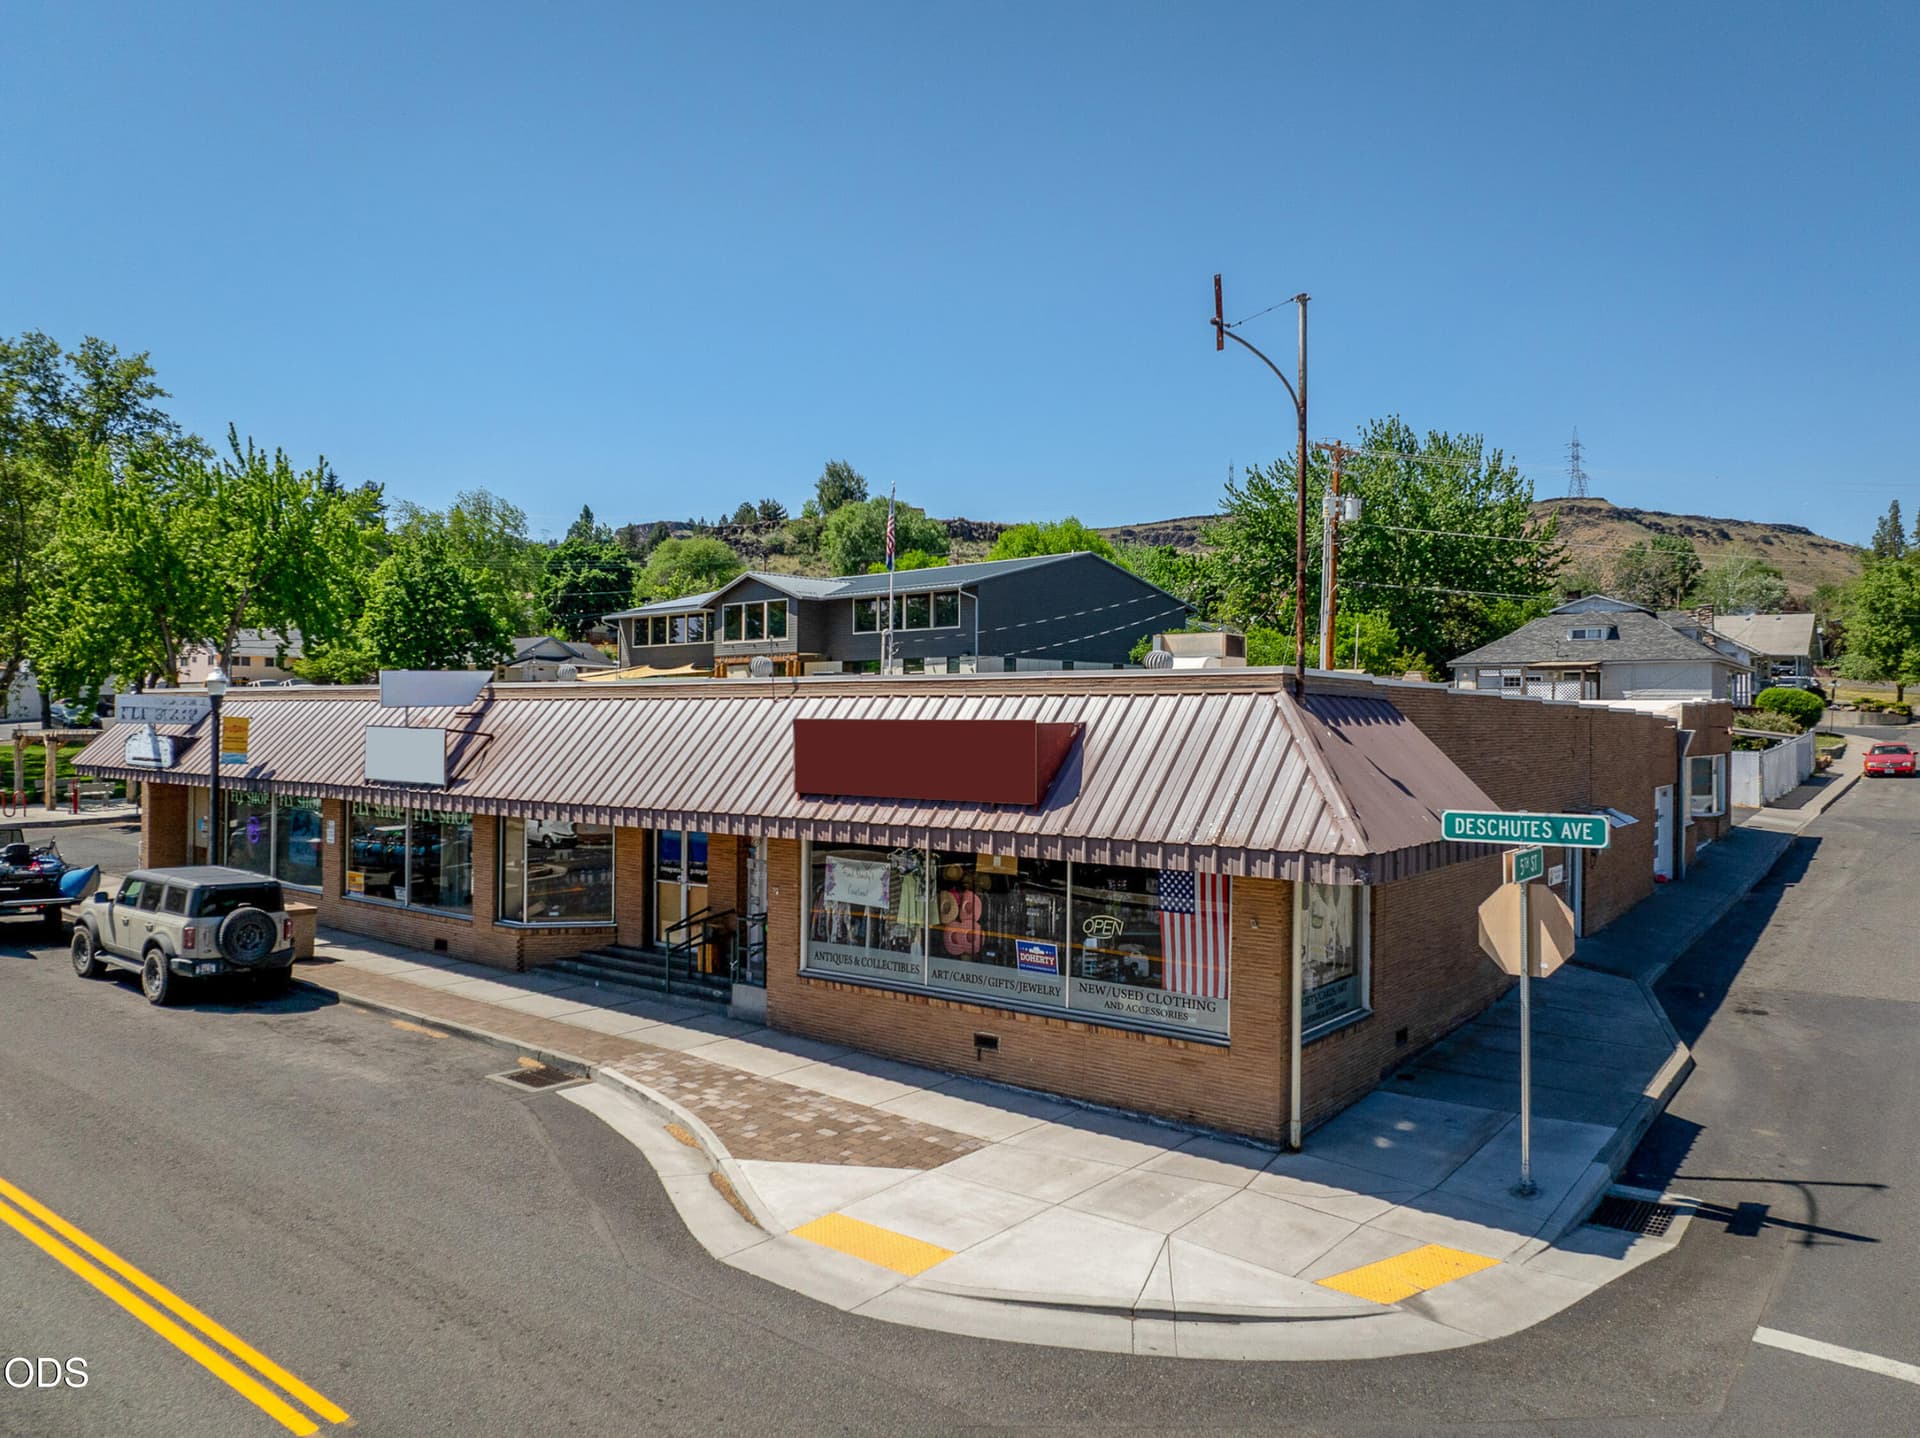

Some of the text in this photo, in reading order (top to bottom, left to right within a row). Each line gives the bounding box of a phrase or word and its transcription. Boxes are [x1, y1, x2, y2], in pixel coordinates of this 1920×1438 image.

[352, 800, 404, 819] FLY SHOP
[414, 808, 472, 825] FLY SHOP
[1454, 817, 1593, 841] DESCHUTES AVE
[1082, 918, 1125, 937] OPEN
[814, 950, 921, 975] ANTIQUES & COLLECTIBLES
[1020, 952, 1055, 966] DOHERTY
[931, 968, 1062, 997] ART/CARDS/GIFTS/JEWELRY
[1079, 982, 1217, 1013] NEW/USED CLOTHING
[1104, 1000, 1190, 1021] AND ACCESSORIES
